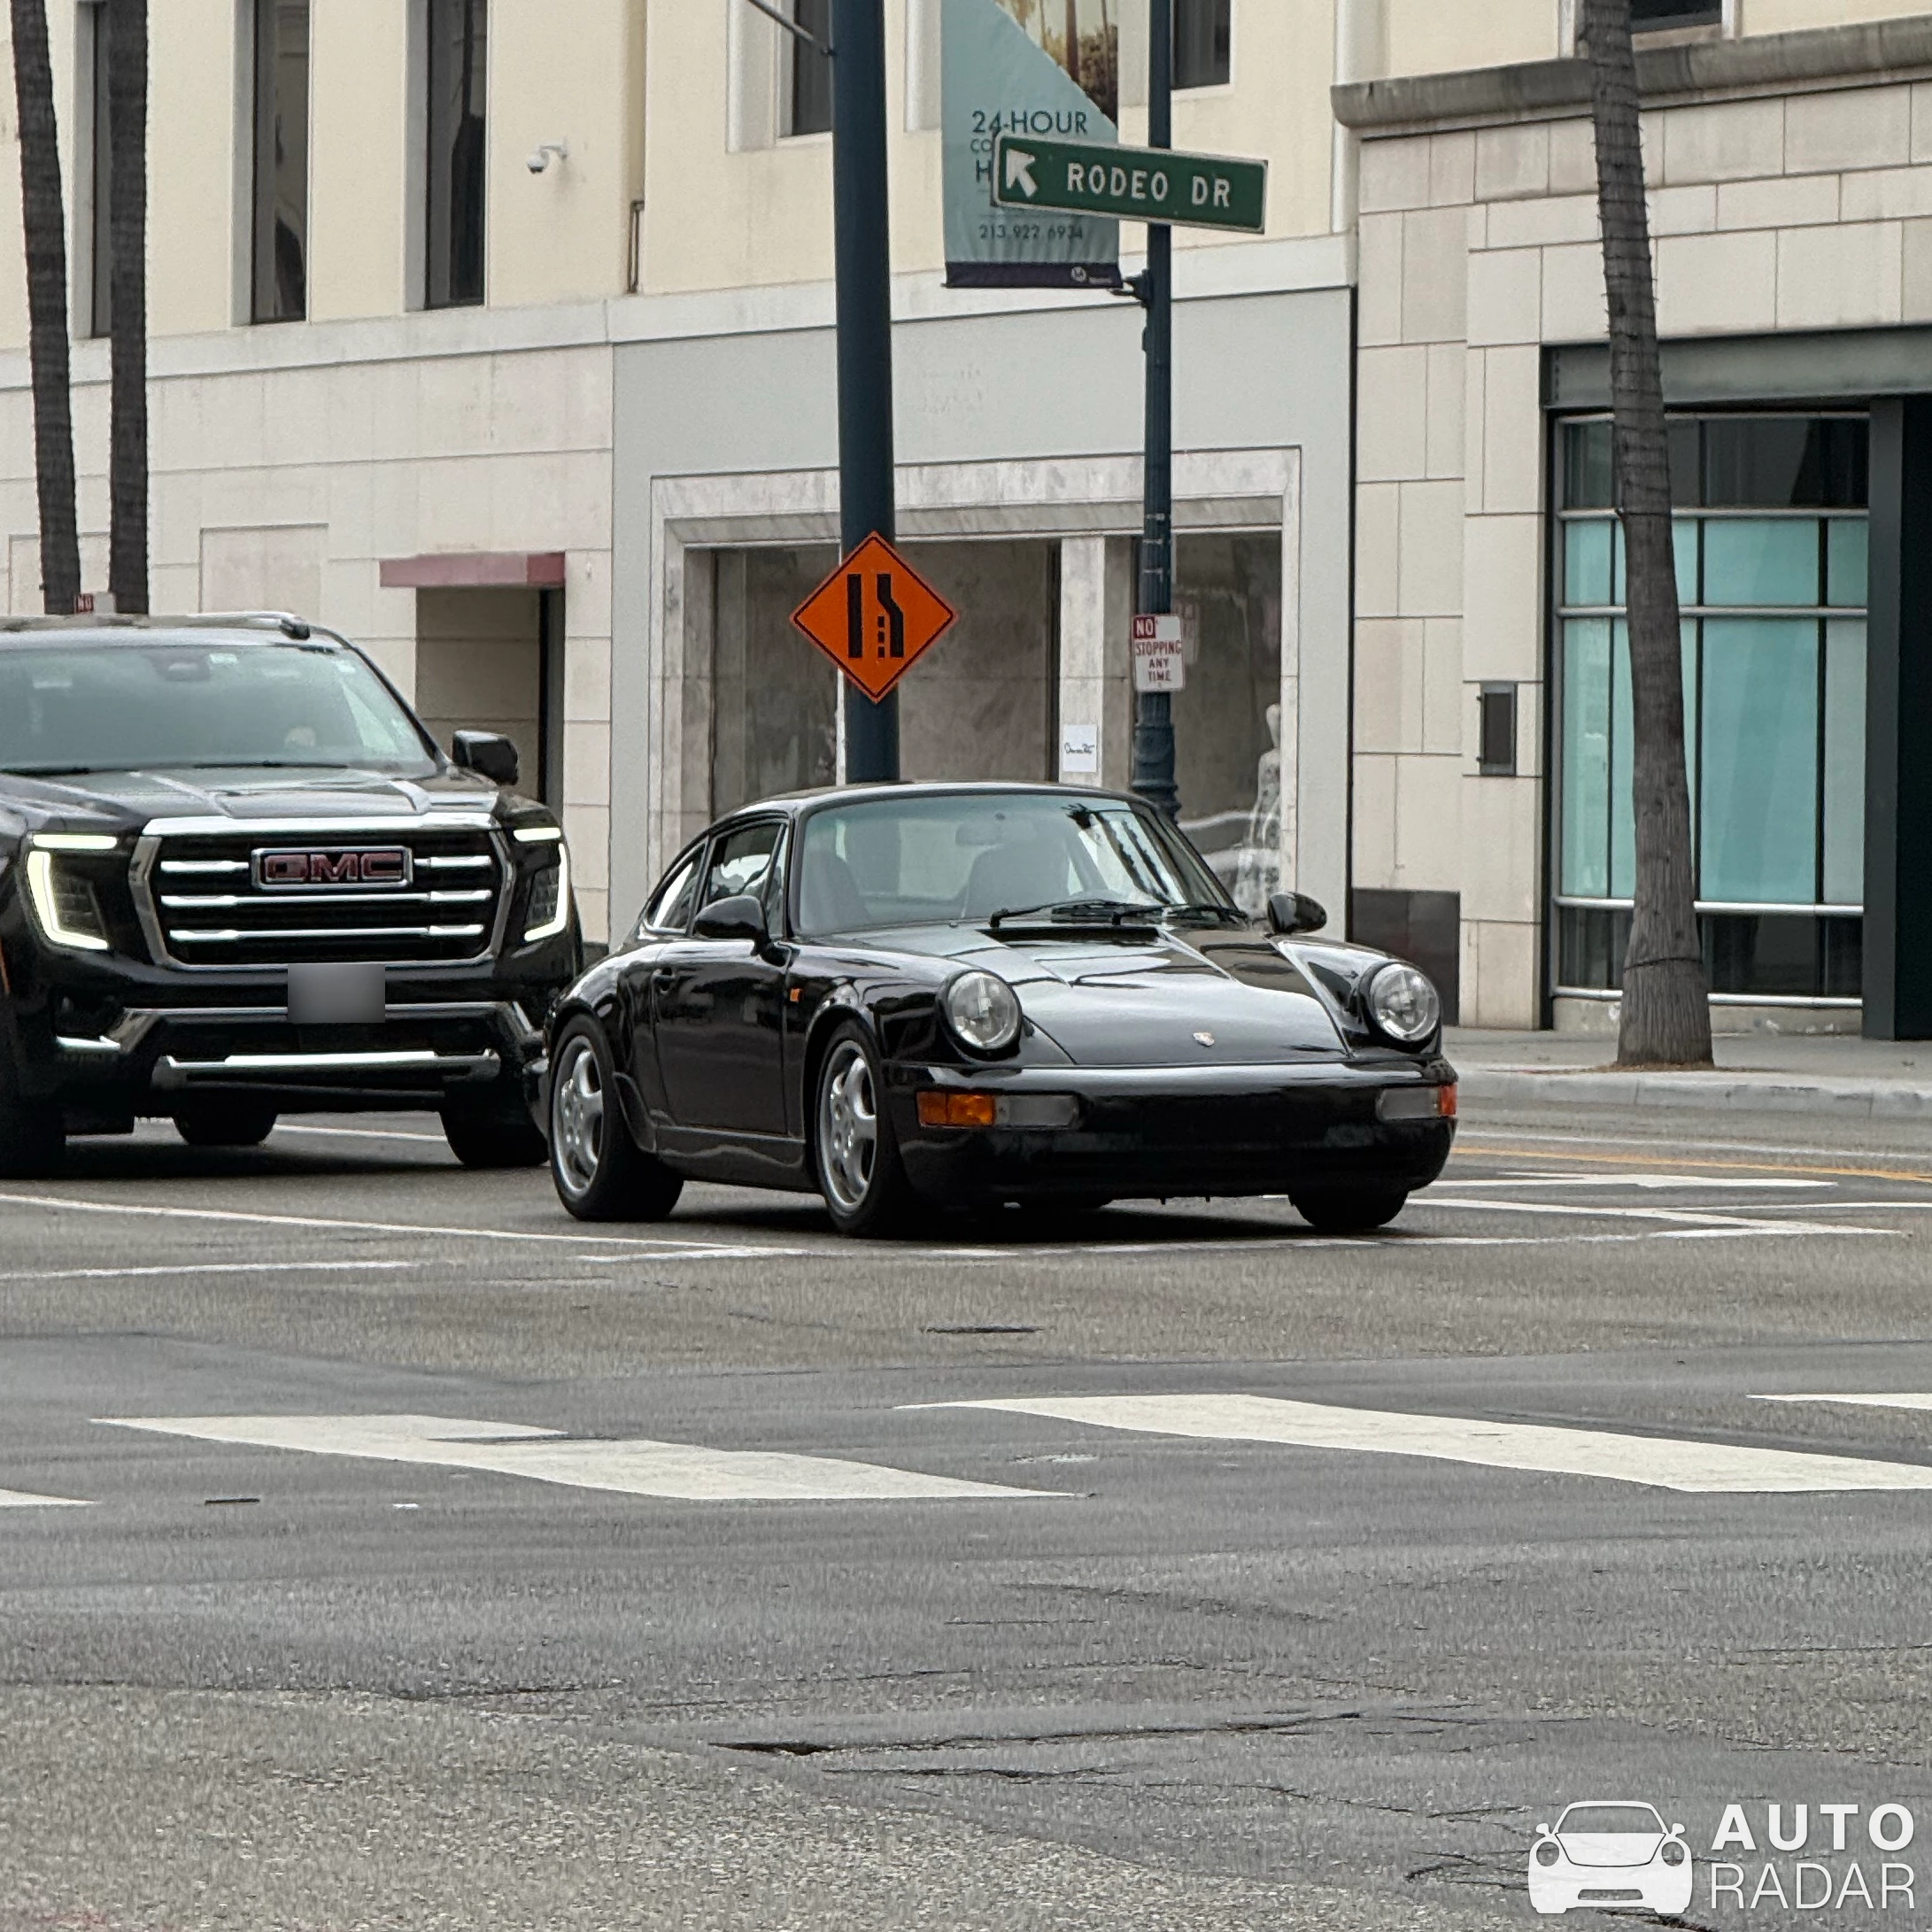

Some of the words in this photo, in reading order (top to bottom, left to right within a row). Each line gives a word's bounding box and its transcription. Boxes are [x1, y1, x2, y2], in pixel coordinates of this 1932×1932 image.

[972, 110, 1088, 134] 24-HOUR
[1067, 162, 1168, 202] RODEO
[1191, 175, 1231, 208] DR
[1136, 618, 1154, 636] NO
[1135, 640, 1182, 656] STOPPING
[1148, 658, 1169, 668] ANY
[1148, 669, 1171, 682] TIME
[264, 853, 402, 882] GMC
